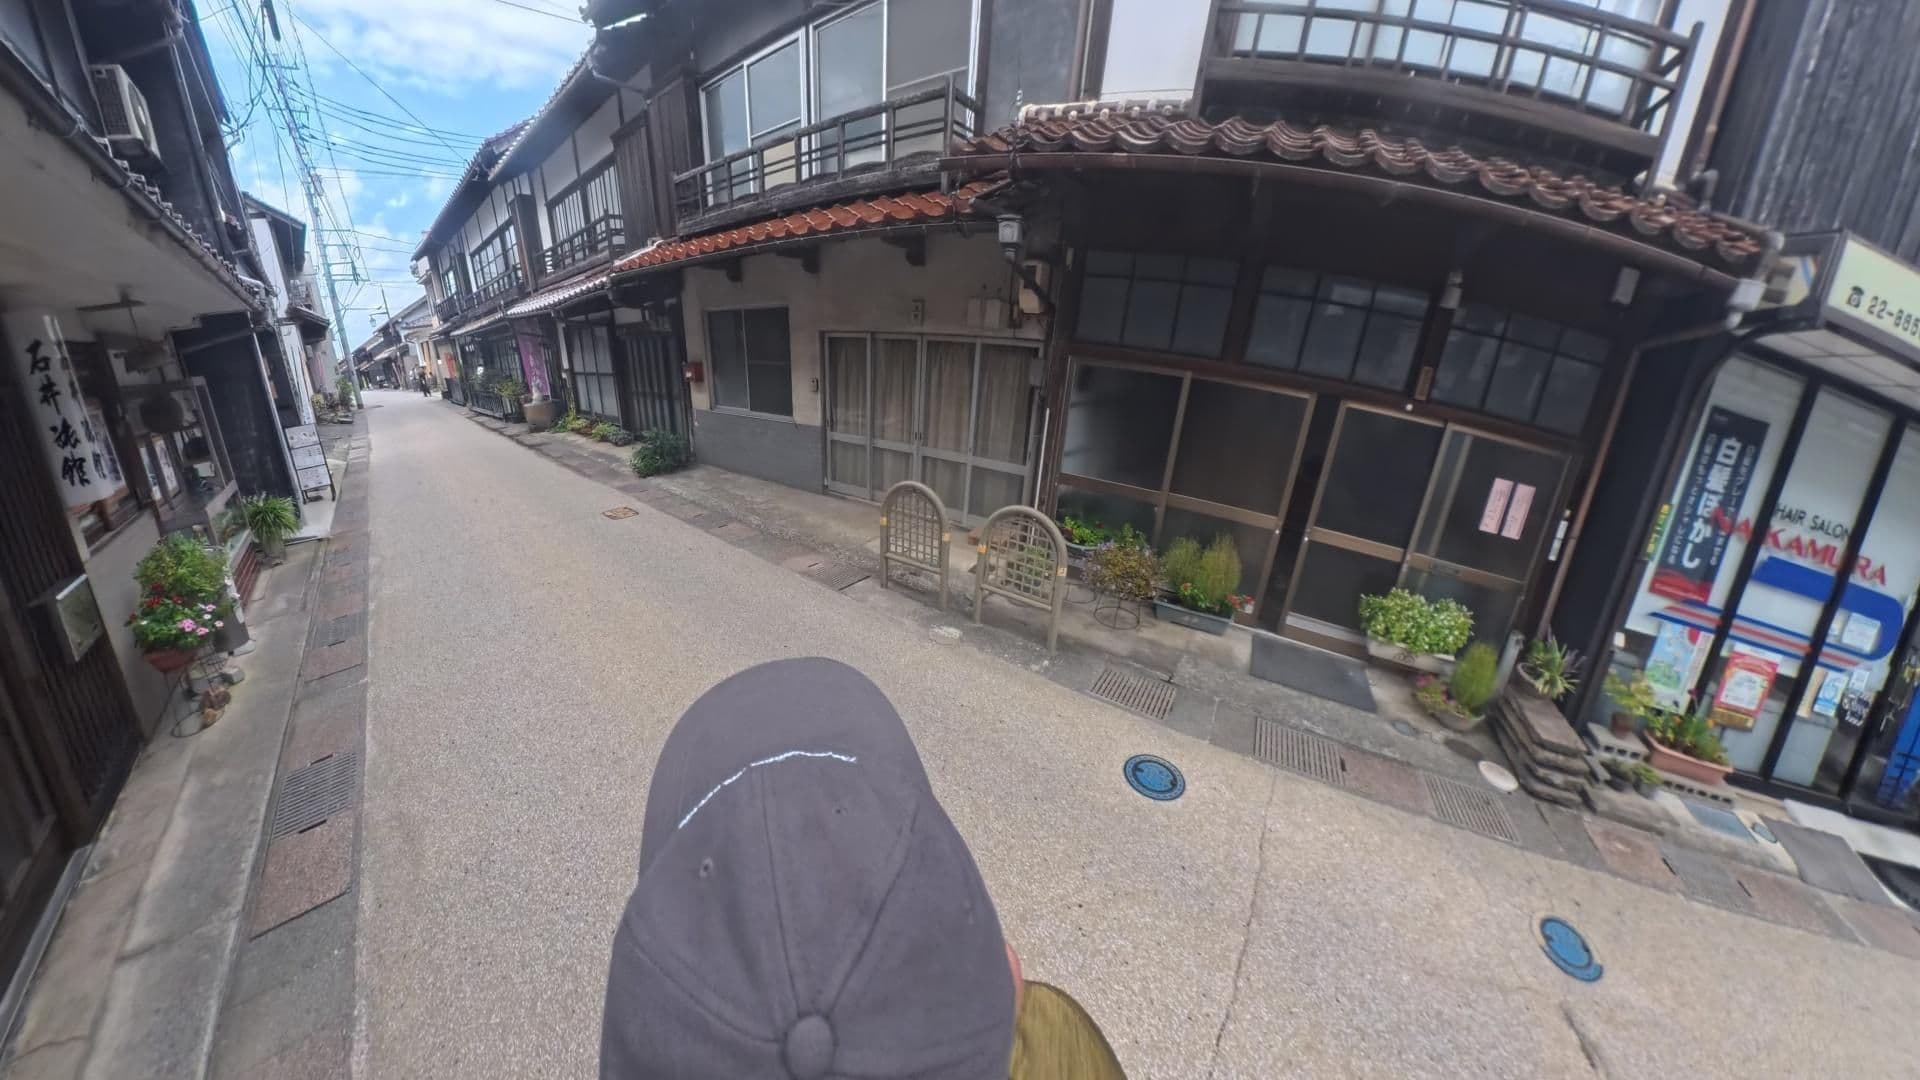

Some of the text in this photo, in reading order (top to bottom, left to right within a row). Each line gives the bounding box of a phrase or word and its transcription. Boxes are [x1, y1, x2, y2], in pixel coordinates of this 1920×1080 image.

[1867, 295, 1920, 341] 22-885
[1774, 503, 1851, 541] HAIR SALON
